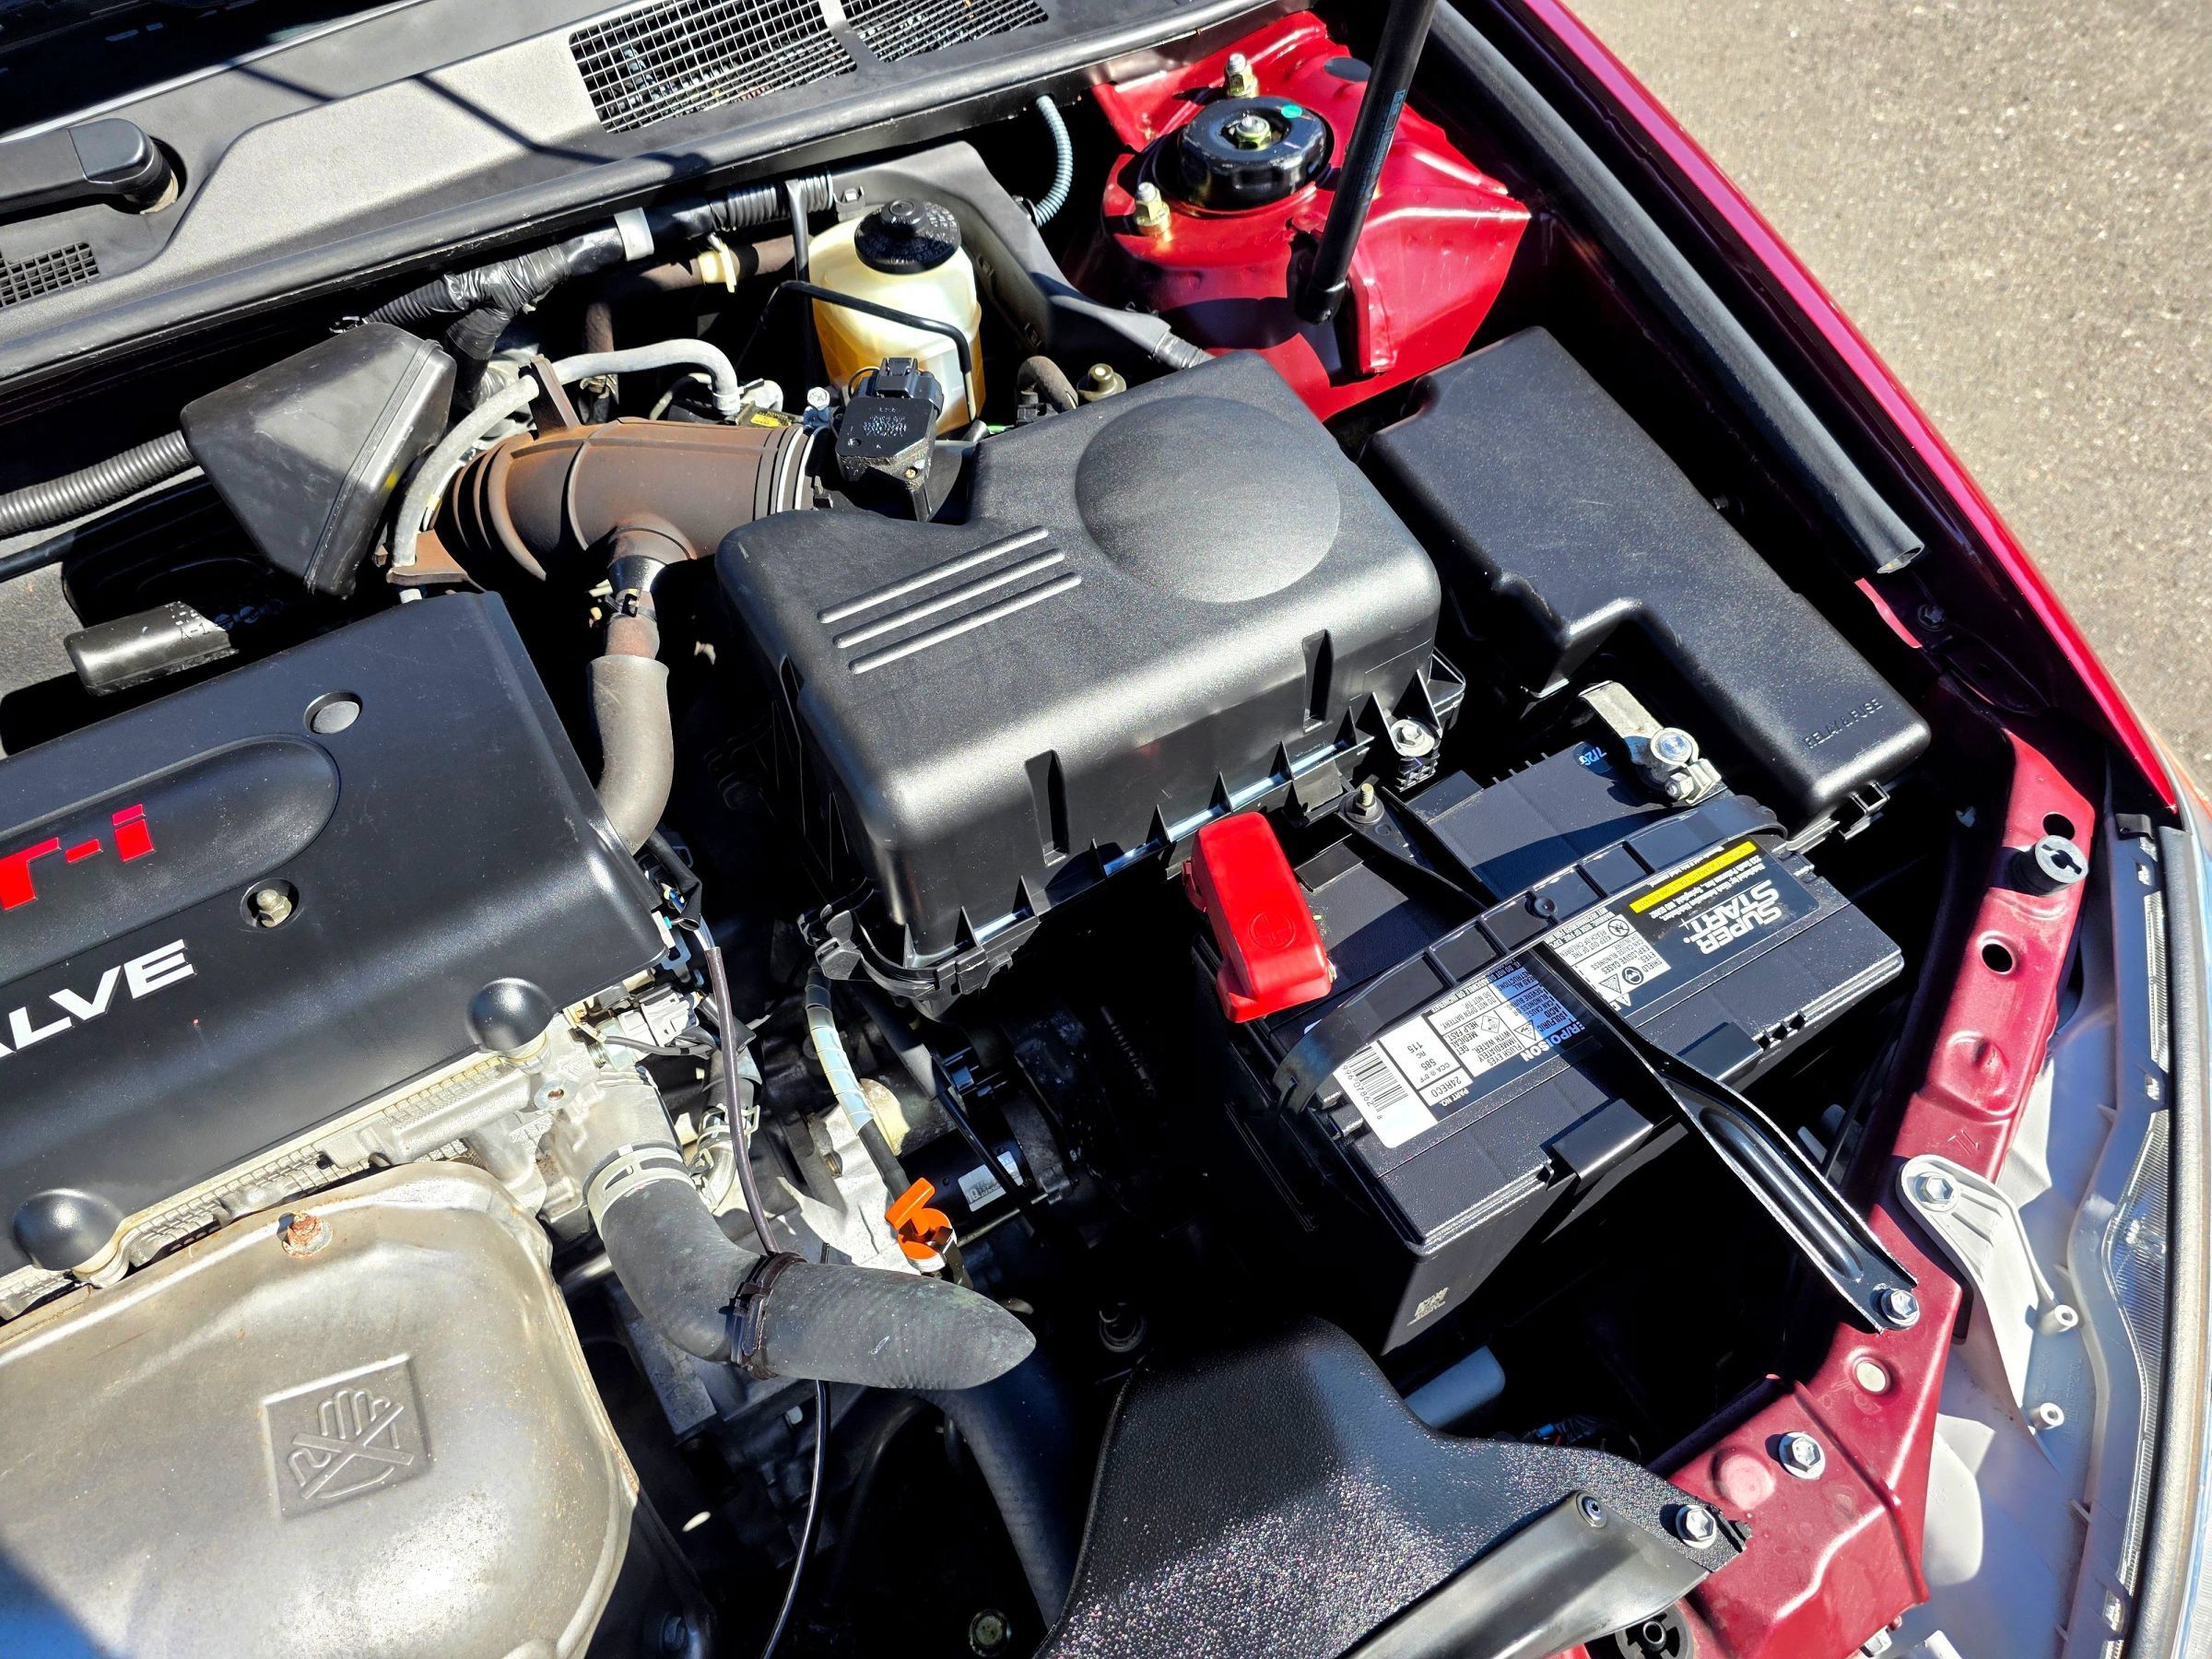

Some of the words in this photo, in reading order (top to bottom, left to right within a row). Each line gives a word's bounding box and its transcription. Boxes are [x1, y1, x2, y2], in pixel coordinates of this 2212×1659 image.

[1804, 720, 1842, 749] RELAY
[1849, 697, 1883, 723] FUSE
[1689, 880, 1780, 942] START
[1562, 912, 1598, 934] RECOMMENDED
[1579, 923, 1593, 933] RISK
[1700, 900, 1783, 955] SUPER
[1589, 929, 1606, 941] REACH
[1597, 935, 1611, 945] KEEP
[1588, 941, 1599, 949] OUT
[1630, 938, 1643, 948] CAN
[1571, 950, 1582, 959] THE
[1616, 945, 1633, 956] CAUSE
[1618, 945, 1649, 964] EXPLOSIVE
[1590, 952, 1618, 970] BLINDNESS
[1637, 951, 1655, 963] EYES.
[1600, 960, 1620, 974] GASES
[1641, 958, 1662, 972] SHIELD
[1494, 969, 1506, 977] NOT
[1462, 973, 1496, 994] DISASSEMBLE
[1512, 981, 1524, 990] ALL
[1455, 990, 1465, 998] OR
[1471, 994, 1483, 1004] NOT
[1523, 987, 1543, 1001] SEVERE
[1461, 1000, 1473, 1008] TIP.
[1476, 1001, 1488, 1010] NOT
[1487, 996, 1496, 1005] DO
[1503, 997, 1524, 1010] BURNS.
[1520, 993, 1548, 1011] BLINDNESS
[1541, 999, 1553, 1008] CAN
[1463, 1006, 1477, 1018] OPEN
[1512, 1007, 1521, 1016] OR
[1524, 1006, 1543, 1018] CAUSE
[1543, 1006, 1559, 1018] ACID
[1461, 1020, 1478, 1032] HELP
[1536, 1013, 1566, 1031] SULFURIC
[1444, 1029, 1463, 1041] FAST.
[1450, 1030, 1477, 1048] MEDICAL
[1493, 1030, 1511, 1042] WITH
[1406, 1041, 1422, 1053] 115
[1455, 1044, 1469, 1055] GET
[1471, 1038, 1495, 1053] WATER.
[1476, 1037, 1516, 1062] IMMEDIATELY
[1501, 1043, 1522, 1057] FLUSH
[1415, 1050, 1426, 1058] RC
[1486, 1053, 1503, 1065] EYES
[1419, 1057, 1436, 1070] 585
[1435, 1062, 1450, 1072] CCA
[1450, 1088, 1469, 1100] PART
[1438, 1097, 1453, 1106] NO.
